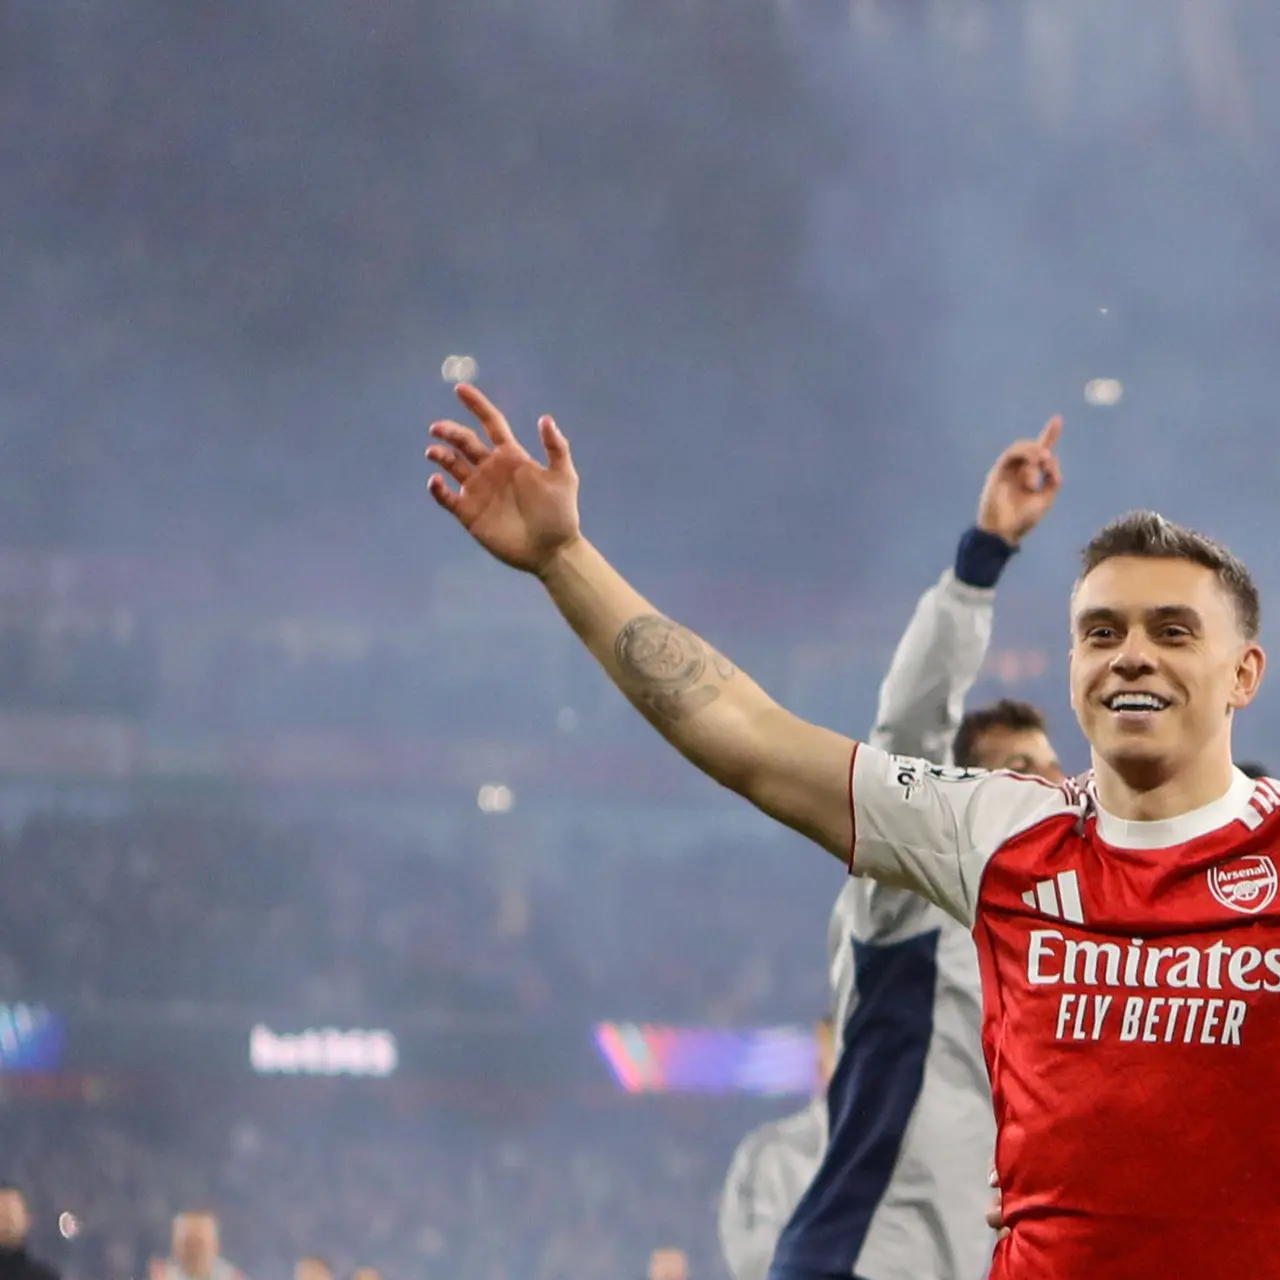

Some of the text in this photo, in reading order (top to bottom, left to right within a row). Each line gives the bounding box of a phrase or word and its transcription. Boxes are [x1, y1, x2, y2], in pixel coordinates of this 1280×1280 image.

[1218, 863, 1266, 882] Arsenal
[1055, 993, 1247, 1046] FLY BETTER
